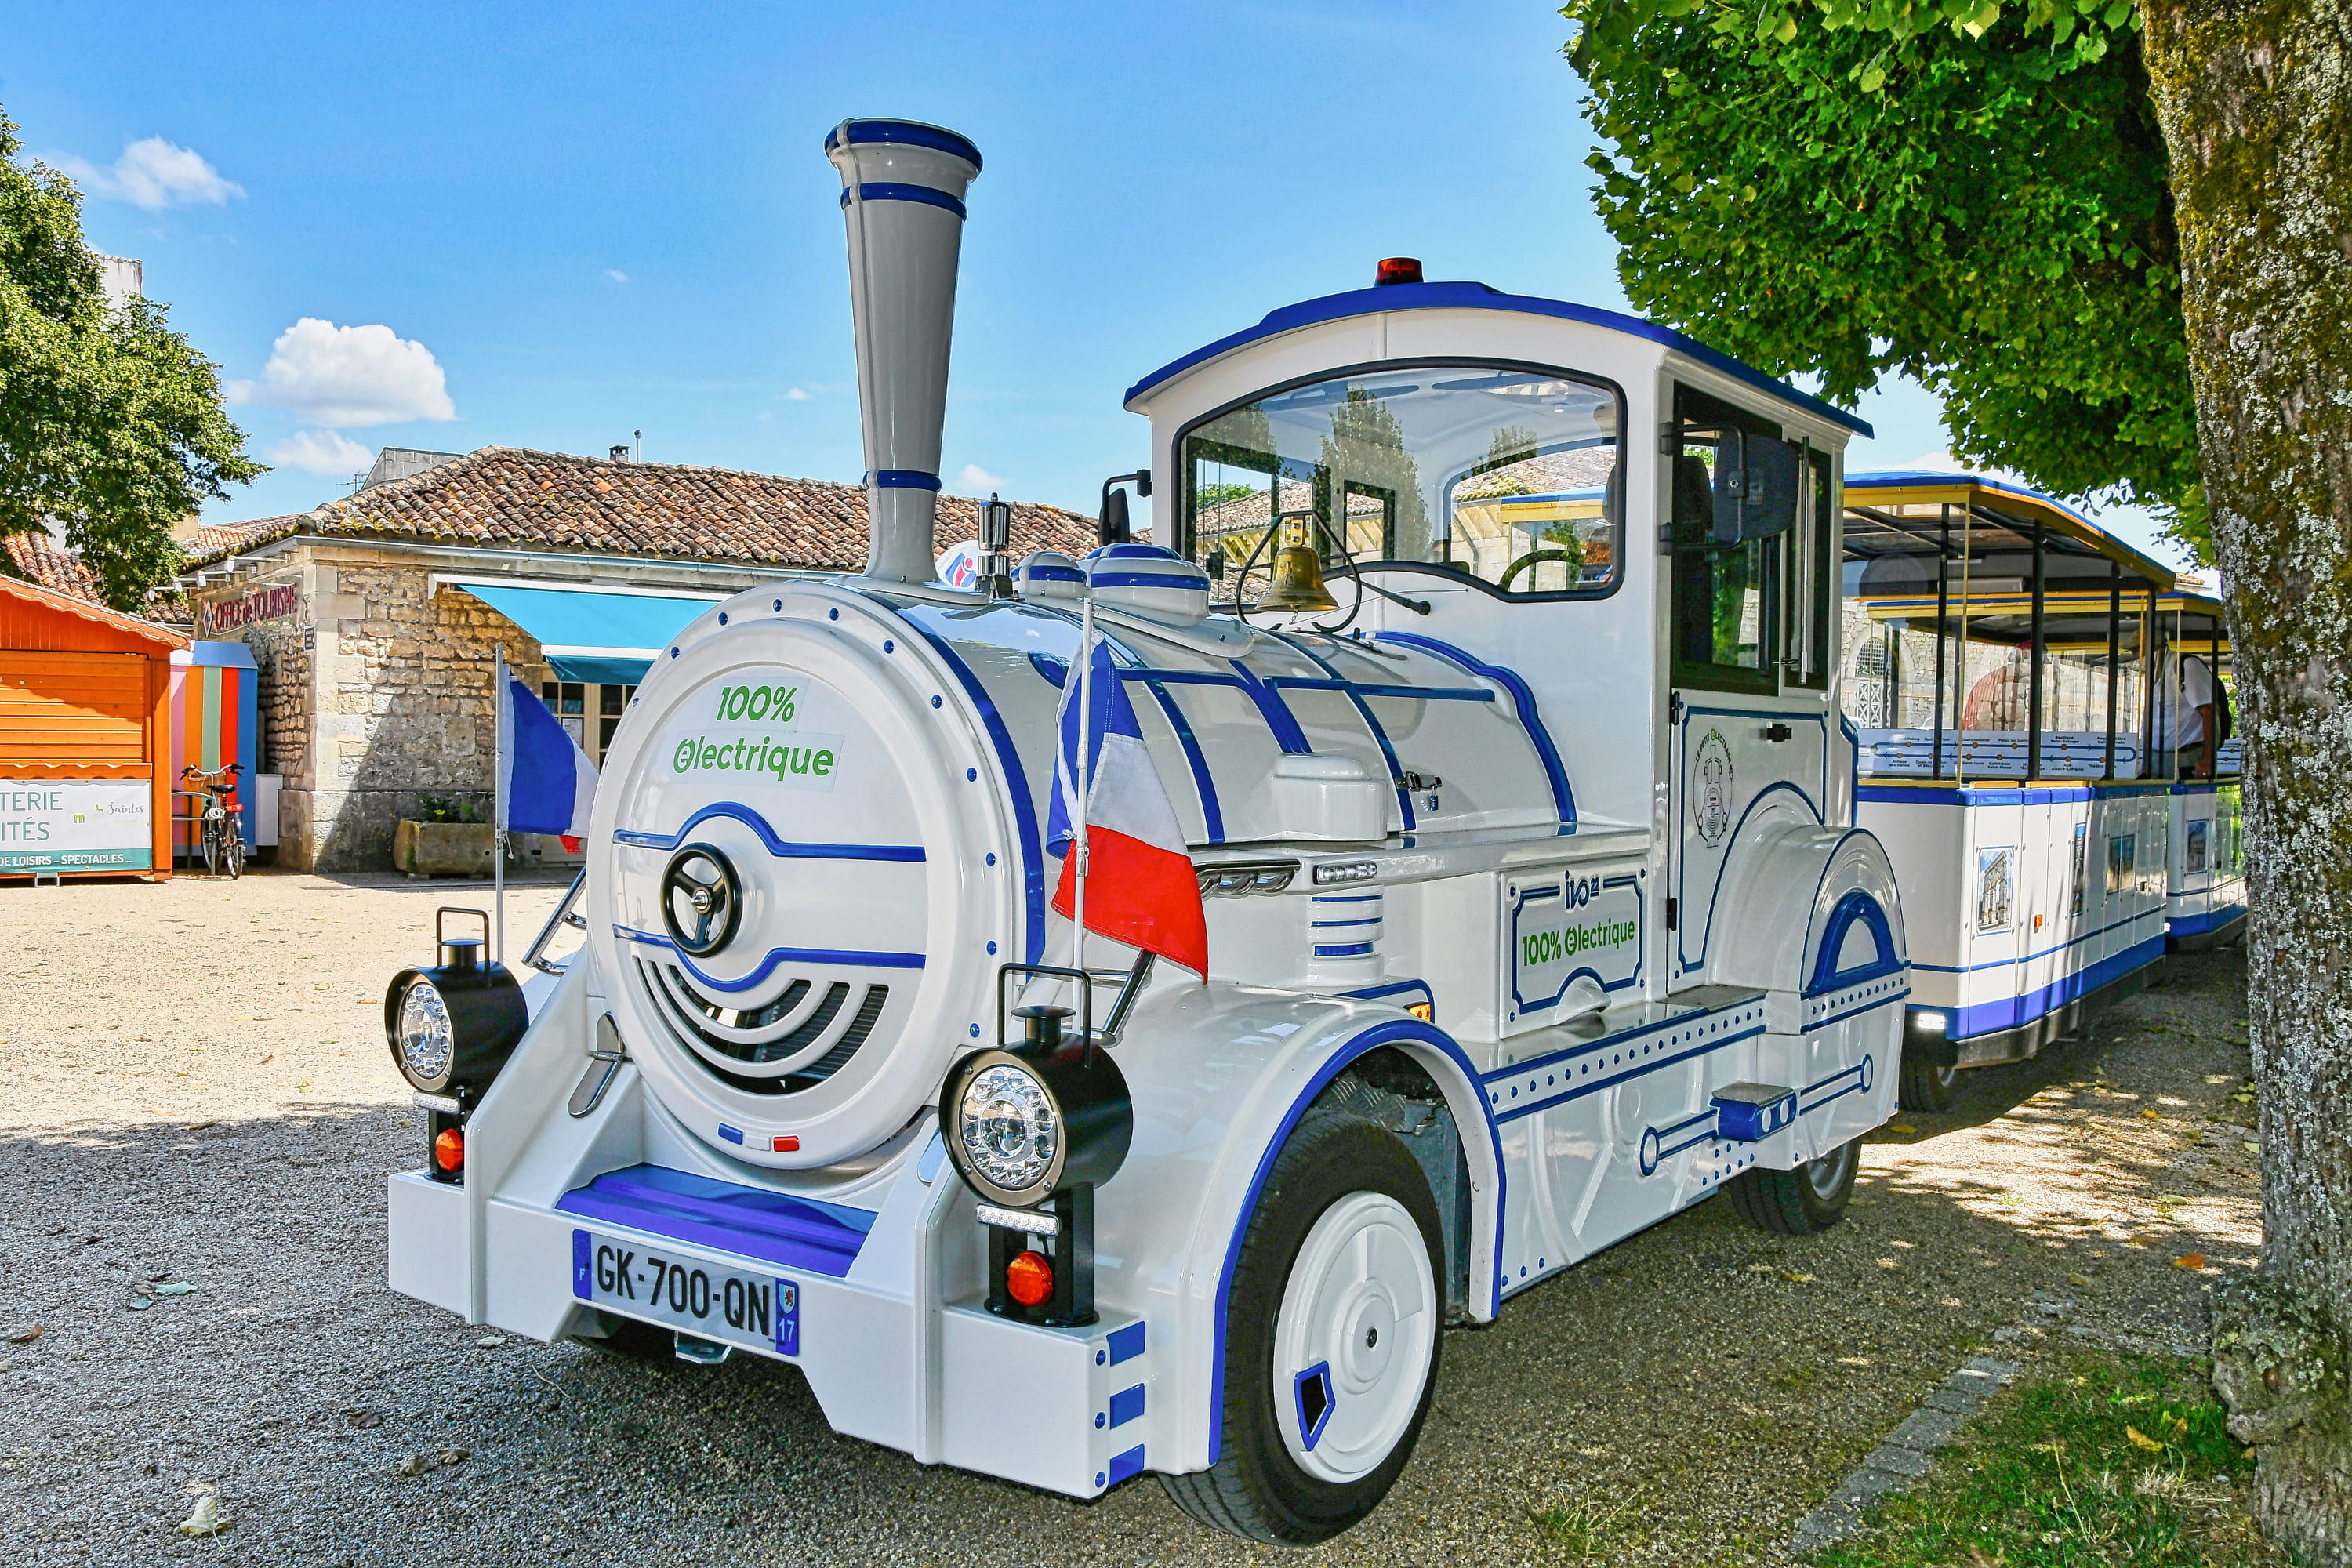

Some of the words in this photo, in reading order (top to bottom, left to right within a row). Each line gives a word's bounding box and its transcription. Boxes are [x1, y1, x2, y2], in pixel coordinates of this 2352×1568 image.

[215, 598, 242, 630] OFFICE
[243, 597, 252, 624] de
[252, 583, 298, 622] TOURISME
[716, 685, 799, 723] 100%
[0, 791, 64, 811] TERIE
[107, 801, 143, 815] Saintes
[1, 816, 50, 841] ITÉS
[13, 855, 52, 866] LOISIRS
[61, 853, 124, 865] SPECTACLES
[1522, 930, 1562, 967] 100%
[579, 1268, 586, 1281] F
[597, 1244, 770, 1337] GK-700-QN
[779, 1319, 795, 1343] 17
